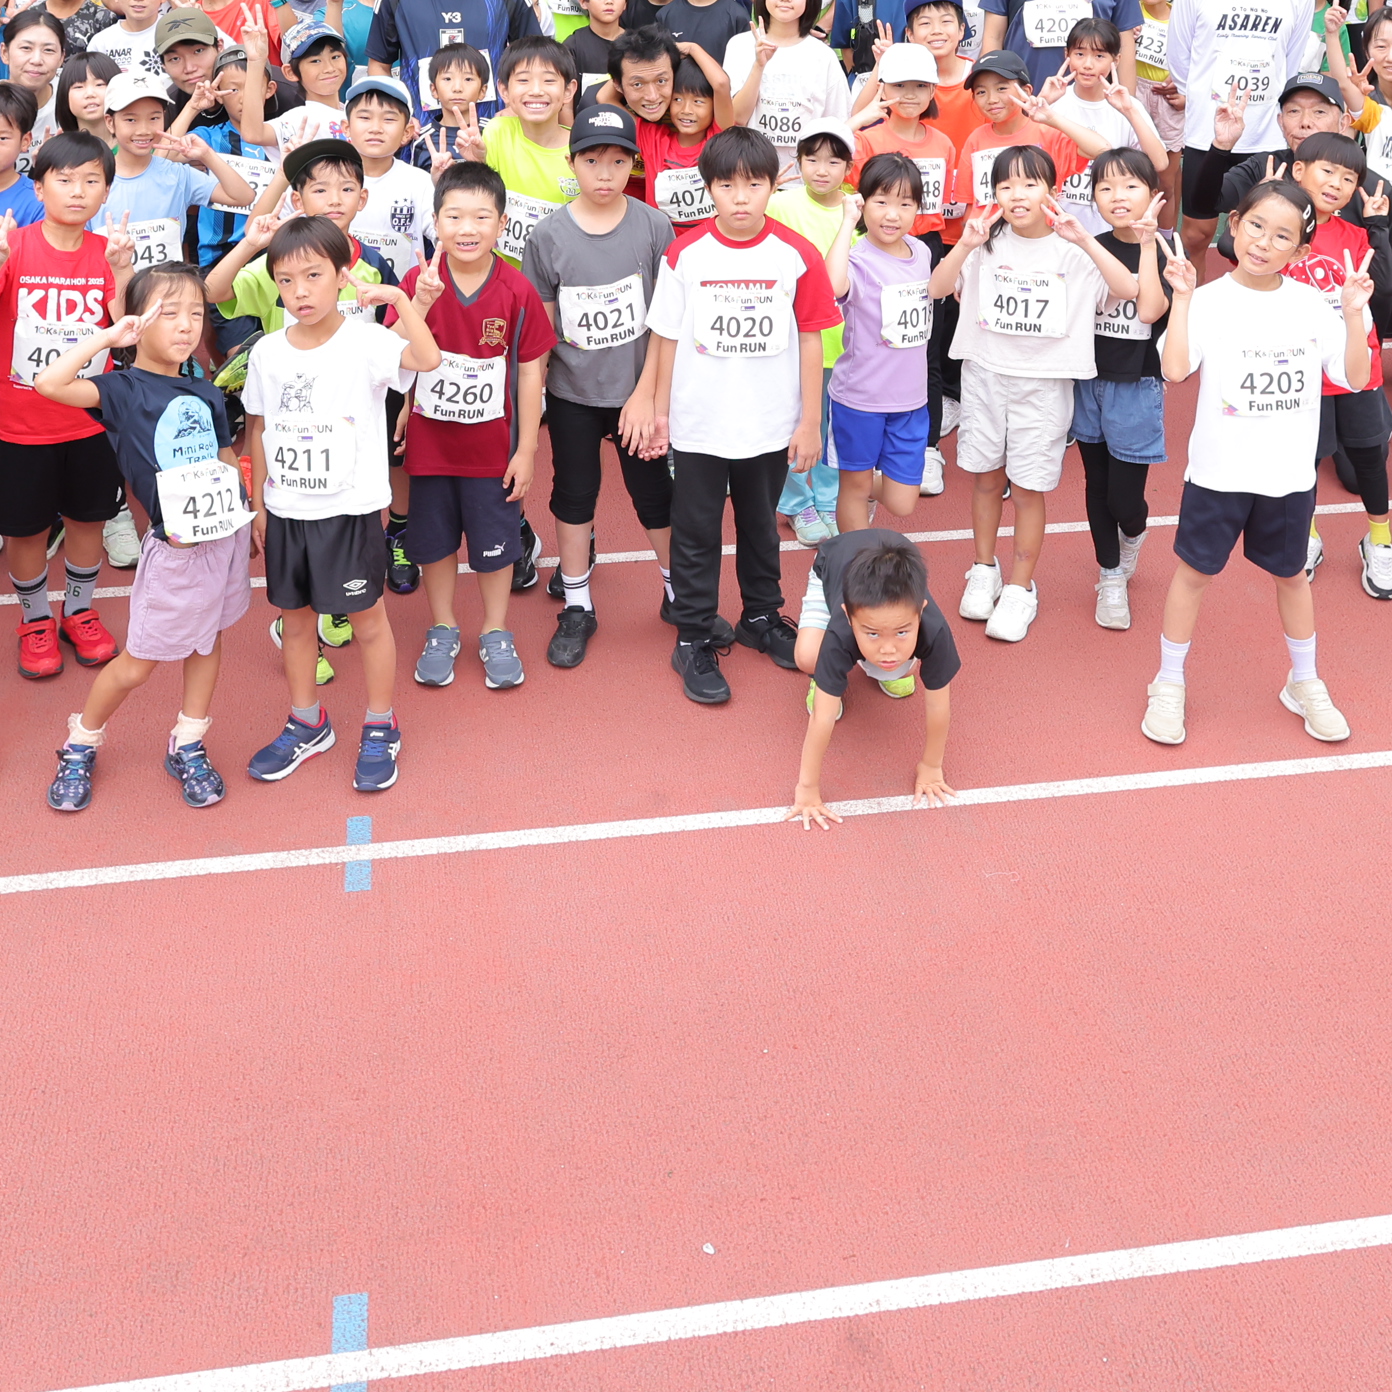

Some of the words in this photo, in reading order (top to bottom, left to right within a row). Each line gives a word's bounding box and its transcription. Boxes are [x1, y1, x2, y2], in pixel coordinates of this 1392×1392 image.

[441, 11, 462, 23] Y-3
[1216, 13, 1283, 35] ASAREN
[107, 47, 132, 58] ANAR
[1135, 34, 1166, 54] 423
[1224, 74, 1270, 92] 4039
[758, 113, 802, 132] 4086
[776, 134, 797, 144] RUN
[668, 188, 707, 209] 407
[503, 217, 534, 239] 408
[19, 275, 47, 285] OSAKA
[87, 277, 105, 286] 2025
[17, 287, 105, 323] KIDS
[993, 295, 1050, 321] 4017
[576, 303, 637, 333] 4021
[710, 314, 774, 338] 4020
[994, 320, 1014, 332] Fun
[1014, 320, 1042, 333] RUN
[586, 334, 609, 346] Fun
[610, 327, 636, 343] RUN
[716, 342, 738, 352] Fun
[739, 342, 767, 353] RUN
[430, 378, 494, 405] 4260
[1240, 369, 1306, 395] 4203
[433, 404, 456, 418] Fun
[457, 406, 486, 419] RUN
[1248, 400, 1273, 411] Fun
[1274, 398, 1301, 411] RUN
[274, 445, 332, 473] 4211
[279, 475, 298, 488] Fun
[299, 476, 328, 490] RUN
[181, 487, 236, 520] 4212
